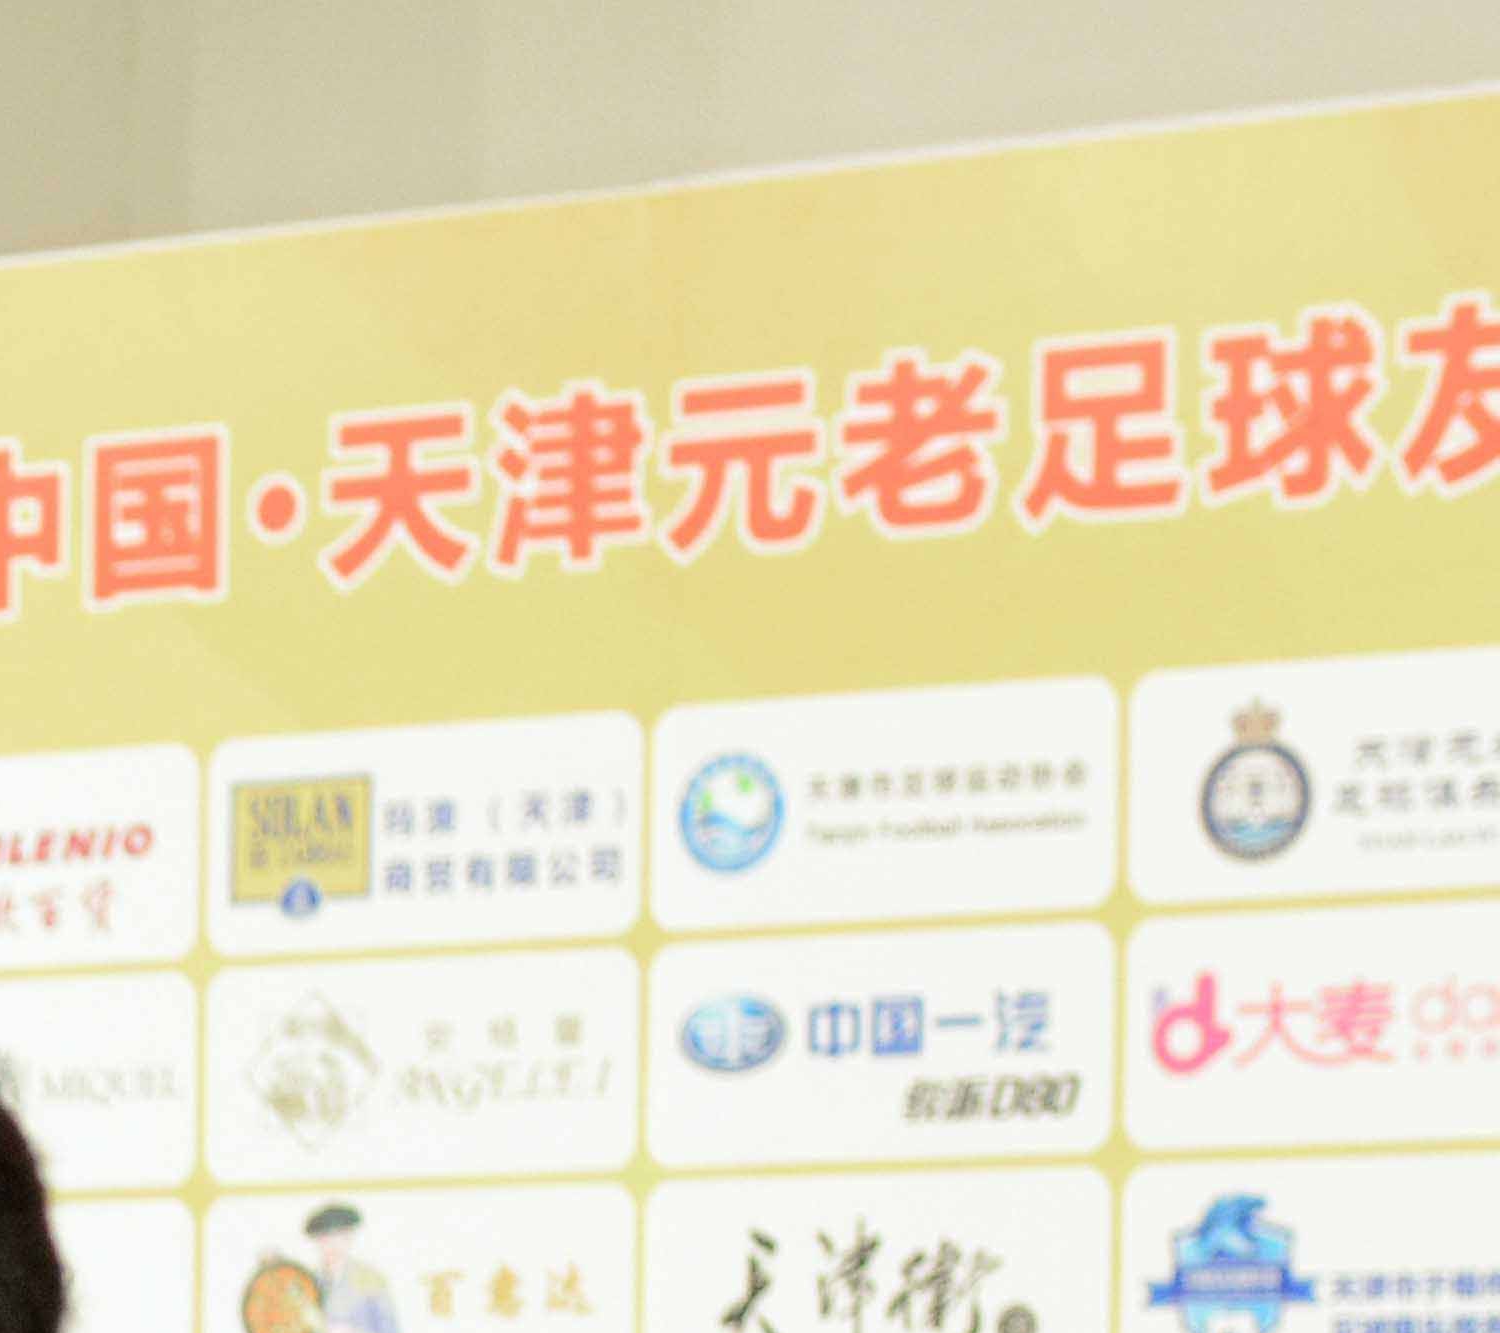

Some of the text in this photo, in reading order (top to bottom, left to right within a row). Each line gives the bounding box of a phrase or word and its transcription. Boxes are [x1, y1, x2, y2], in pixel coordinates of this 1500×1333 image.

[808, 988, 1051, 1057] 中国一汽
[1234, 980, 1394, 1067] 大麦
